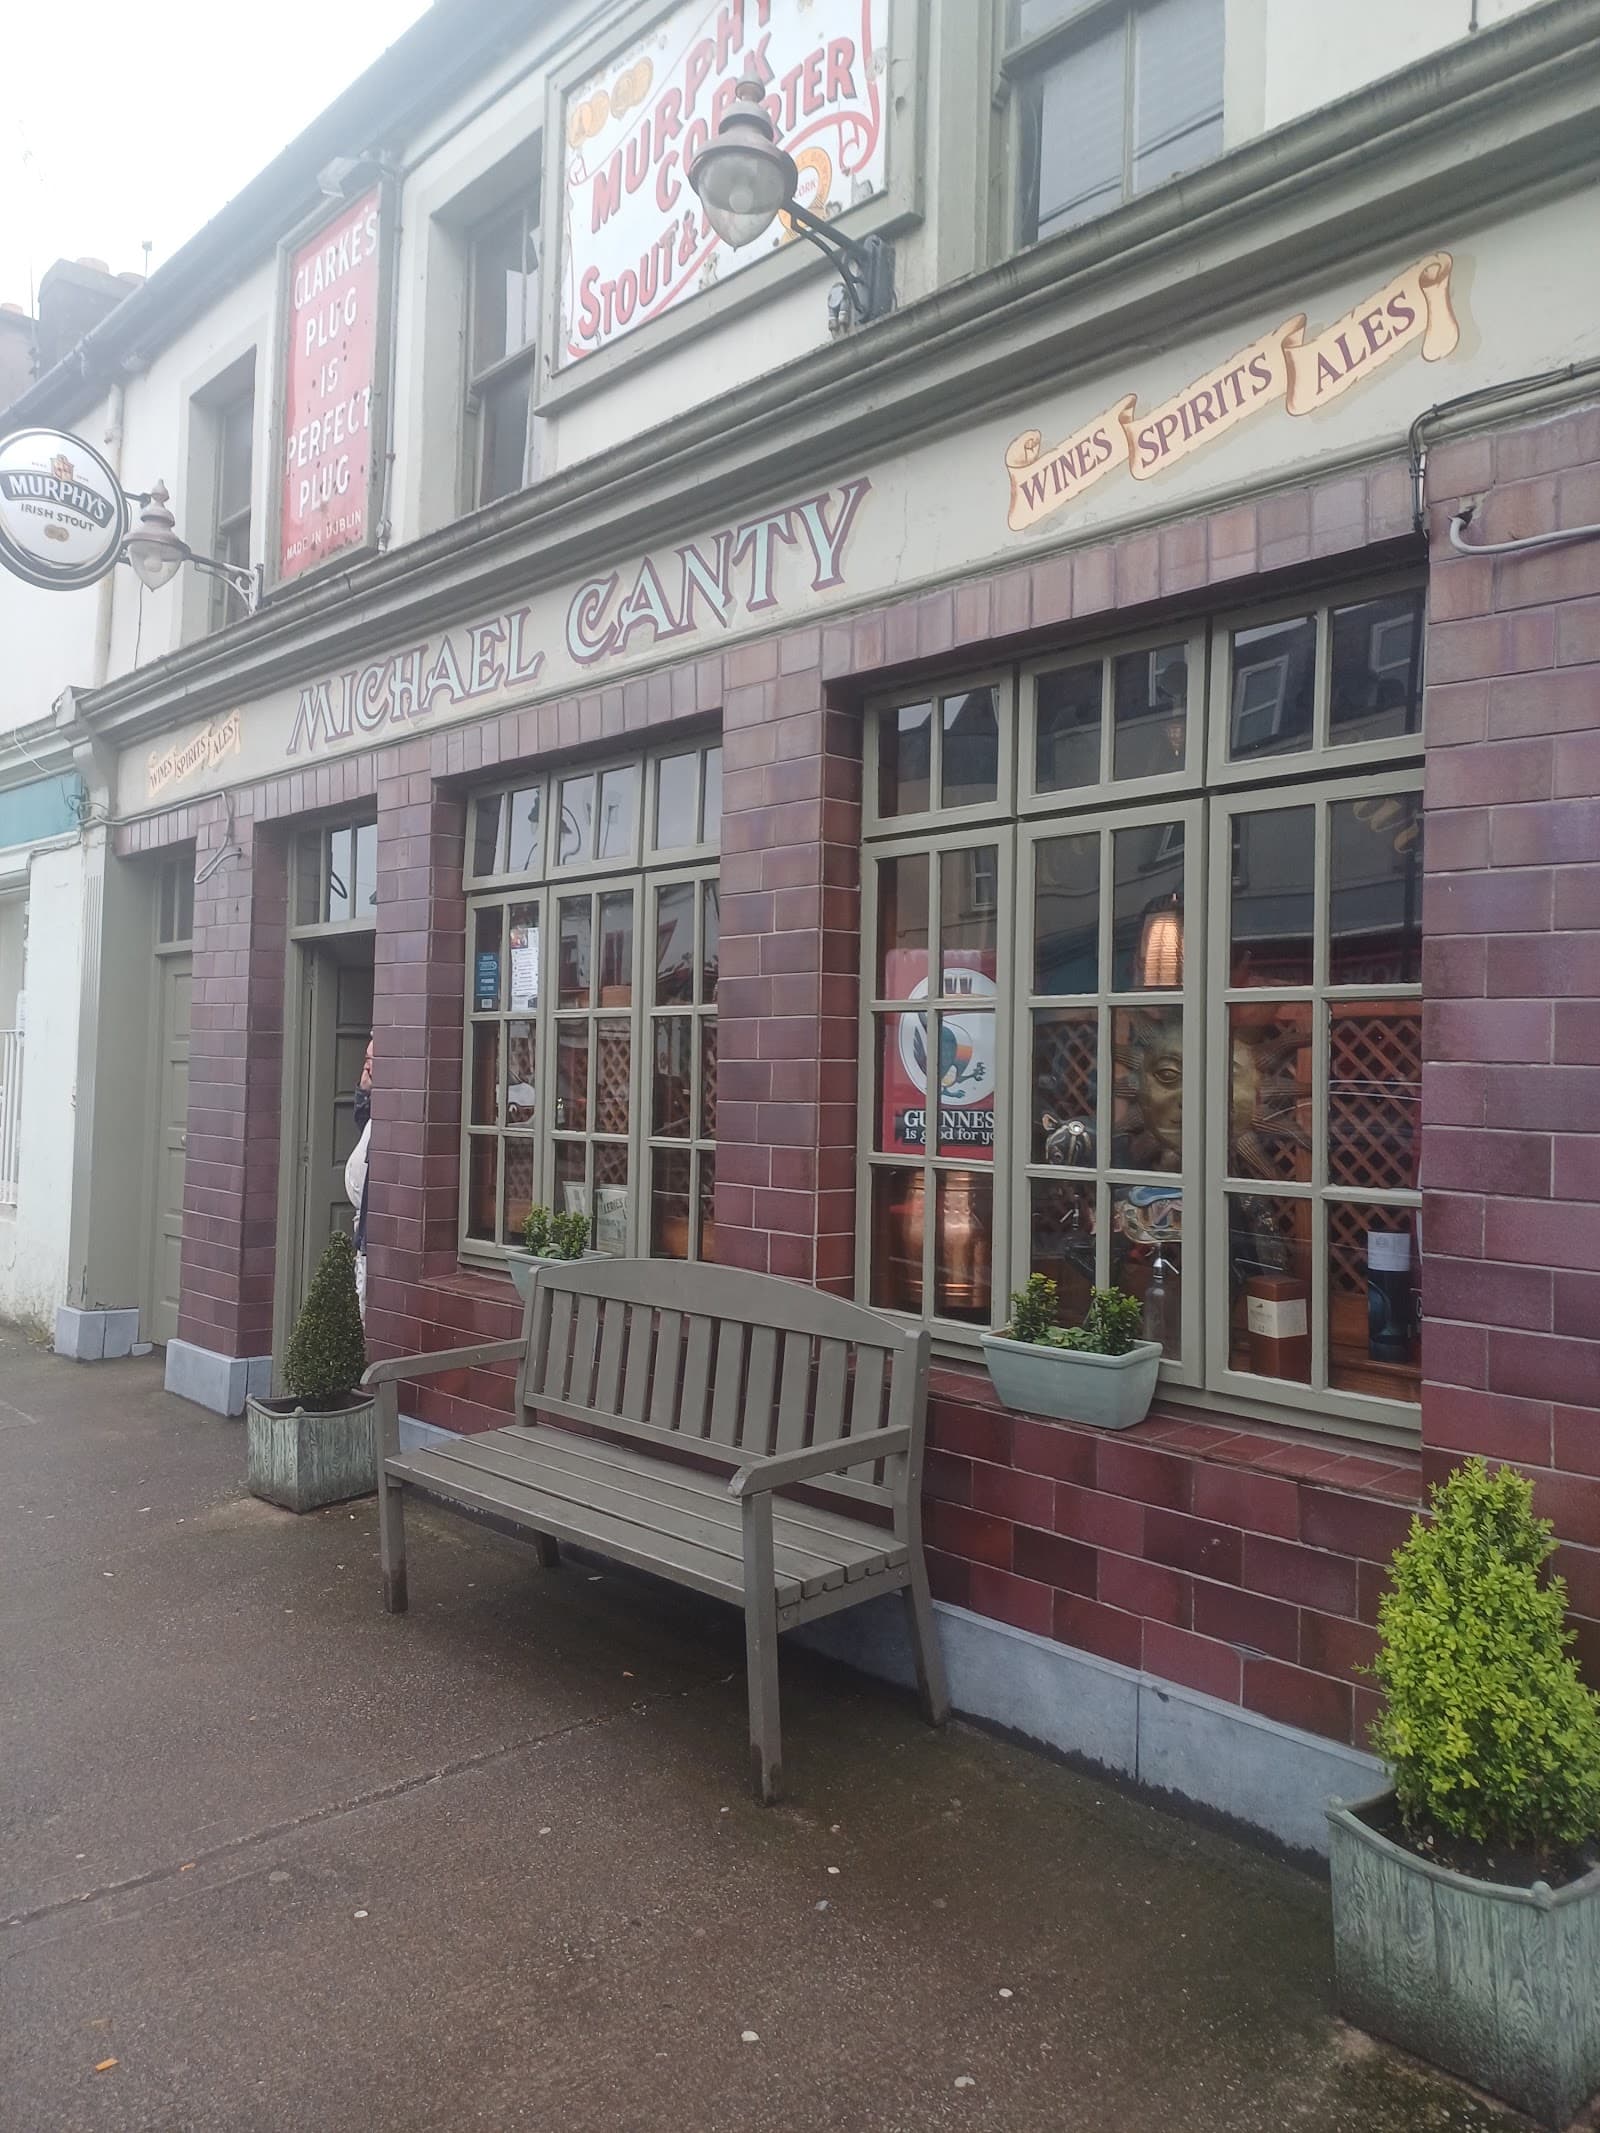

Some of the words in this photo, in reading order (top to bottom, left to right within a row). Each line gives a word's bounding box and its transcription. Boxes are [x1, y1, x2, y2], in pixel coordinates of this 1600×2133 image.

[294, 205, 377, 311] CLARKE'S
[578, 219, 680, 340] STOUT
[678, 209, 699, 266] &
[306, 287, 357, 356] PLUG
[320, 357, 340, 398] IS
[1019, 427, 1114, 511] WINES
[1136, 351, 1273, 468] SPIRITS
[1315, 290, 1417, 395] ALES
[286, 386, 371, 475] PERFECT
[21, 503, 54, 519] IRISH
[56, 513, 95, 532] STOUT
[299, 454, 350, 518] PLUG
[286, 536, 309, 561] MADE
[285, 607, 546, 756] MICHAEL
[564, 477, 873, 665] CANTY
[905, 1128, 917, 1139] is
[958, 1128, 978, 1140] for
